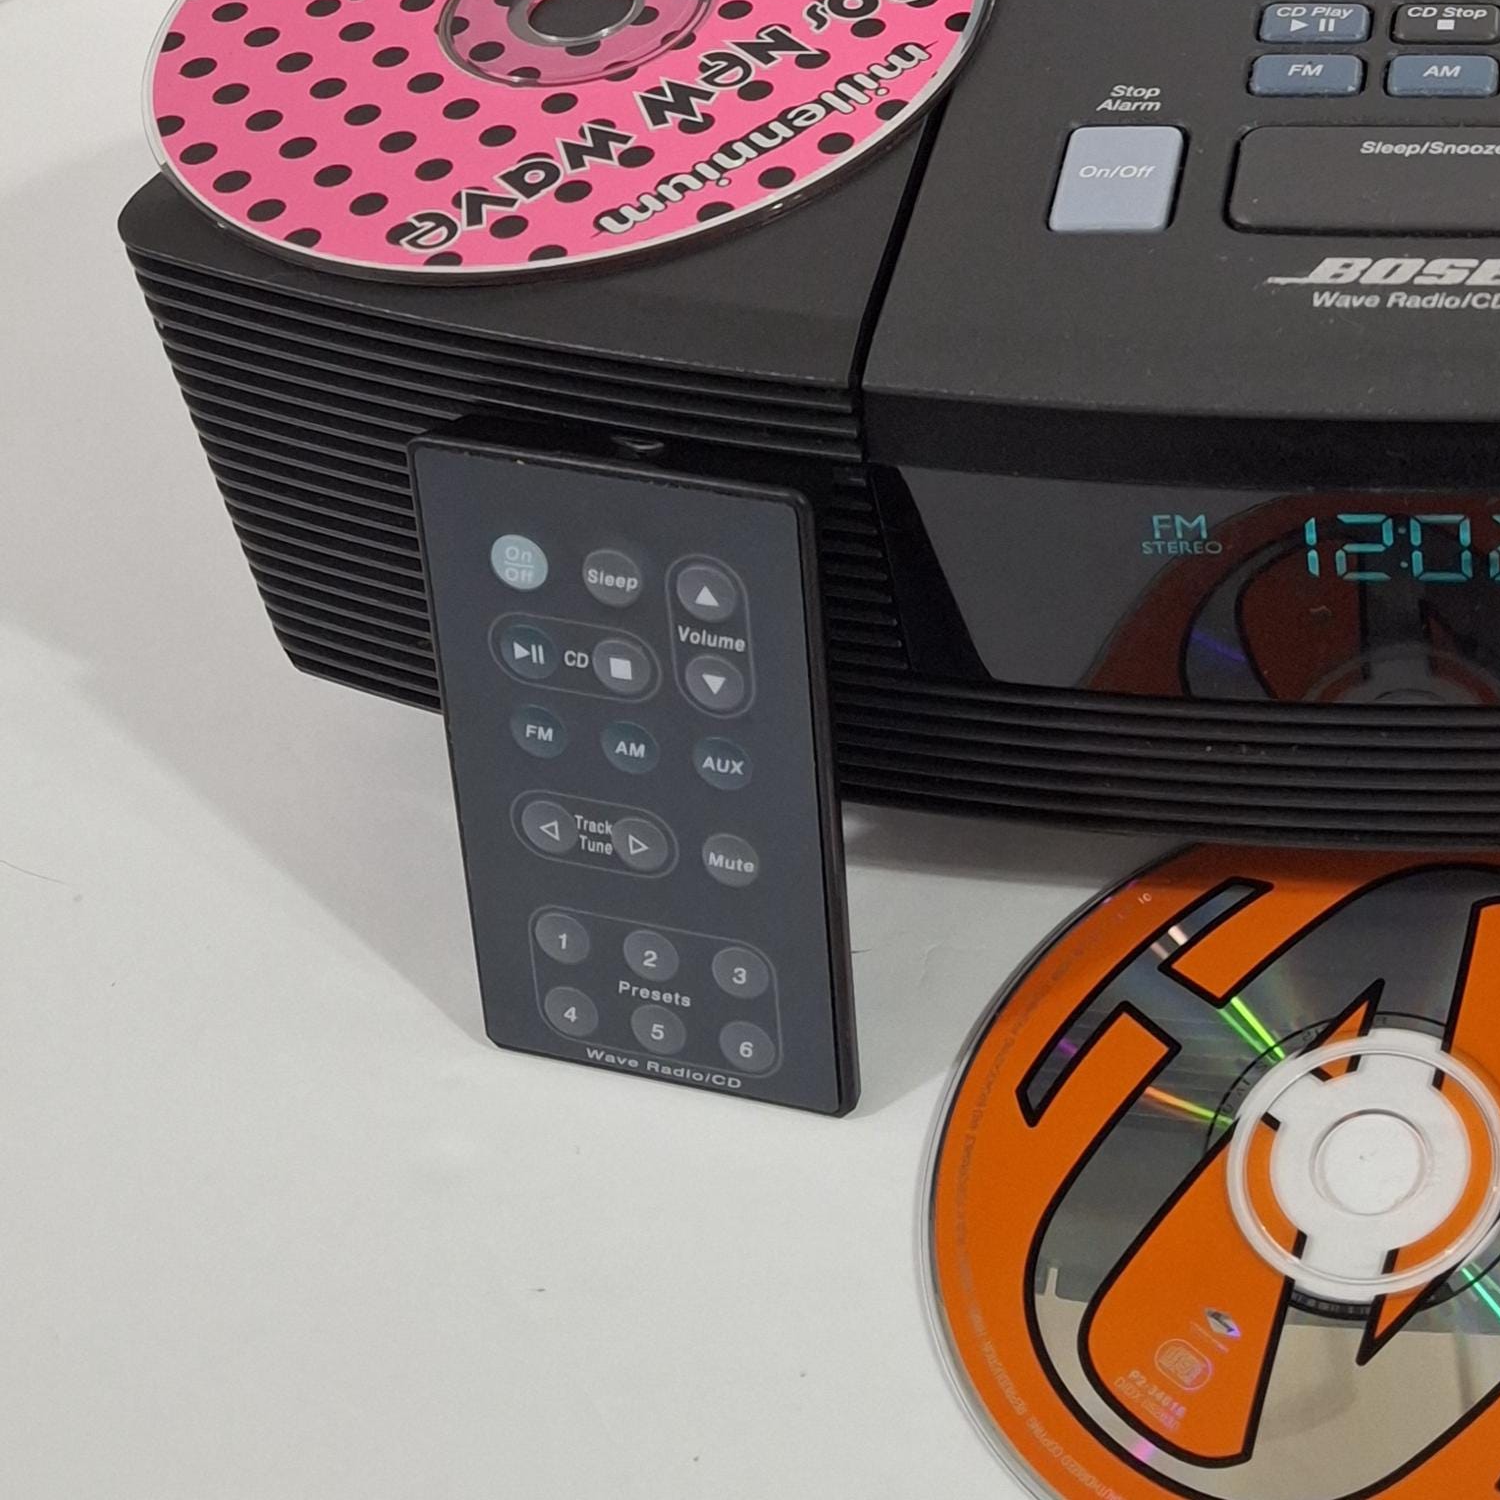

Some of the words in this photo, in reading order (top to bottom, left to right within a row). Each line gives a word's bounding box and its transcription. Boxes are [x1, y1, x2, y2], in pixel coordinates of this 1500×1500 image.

[1276, 7, 1309, 18] CD
[1311, 6, 1353, 19] Play
[1407, 7, 1439, 18] CD
[1443, 7, 1487, 20] Stop
[1288, 64, 1323, 77] FM
[1423, 64, 1460, 78] AM
[1110, 85, 1160, 101] Stop
[1097, 99, 1161, 112] Alarm
[592, 39, 934, 237] millennium
[1079, 164, 1156, 179] On/Off
[1312, 293, 1379, 309] Wave
[1153, 515, 1208, 540] FM
[504, 546, 534, 561] On
[1142, 541, 1222, 554] STEREO
[504, 567, 534, 584] Off
[587, 569, 638, 592] Sleep
[678, 625, 745, 652] Volume
[564, 650, 589, 669] CD
[526, 725, 553, 742] FM
[615, 741, 645, 758] AM
[702, 756, 744, 775] AUX
[575, 815, 613, 836] Track
[579, 835, 613, 856] Tune
[708, 853, 755, 873] Mute
[558, 934, 568, 950] 1
[643, 951, 658, 968] 2
[732, 968, 747, 984] 3
[618, 980, 691, 1008] Presets
[563, 1006, 577, 1023] 4
[651, 1025, 665, 1041] 5
[740, 1041, 753, 1058] 6
[586, 1047, 639, 1069] Wave
[646, 1060, 742, 1089] Radio/CD
